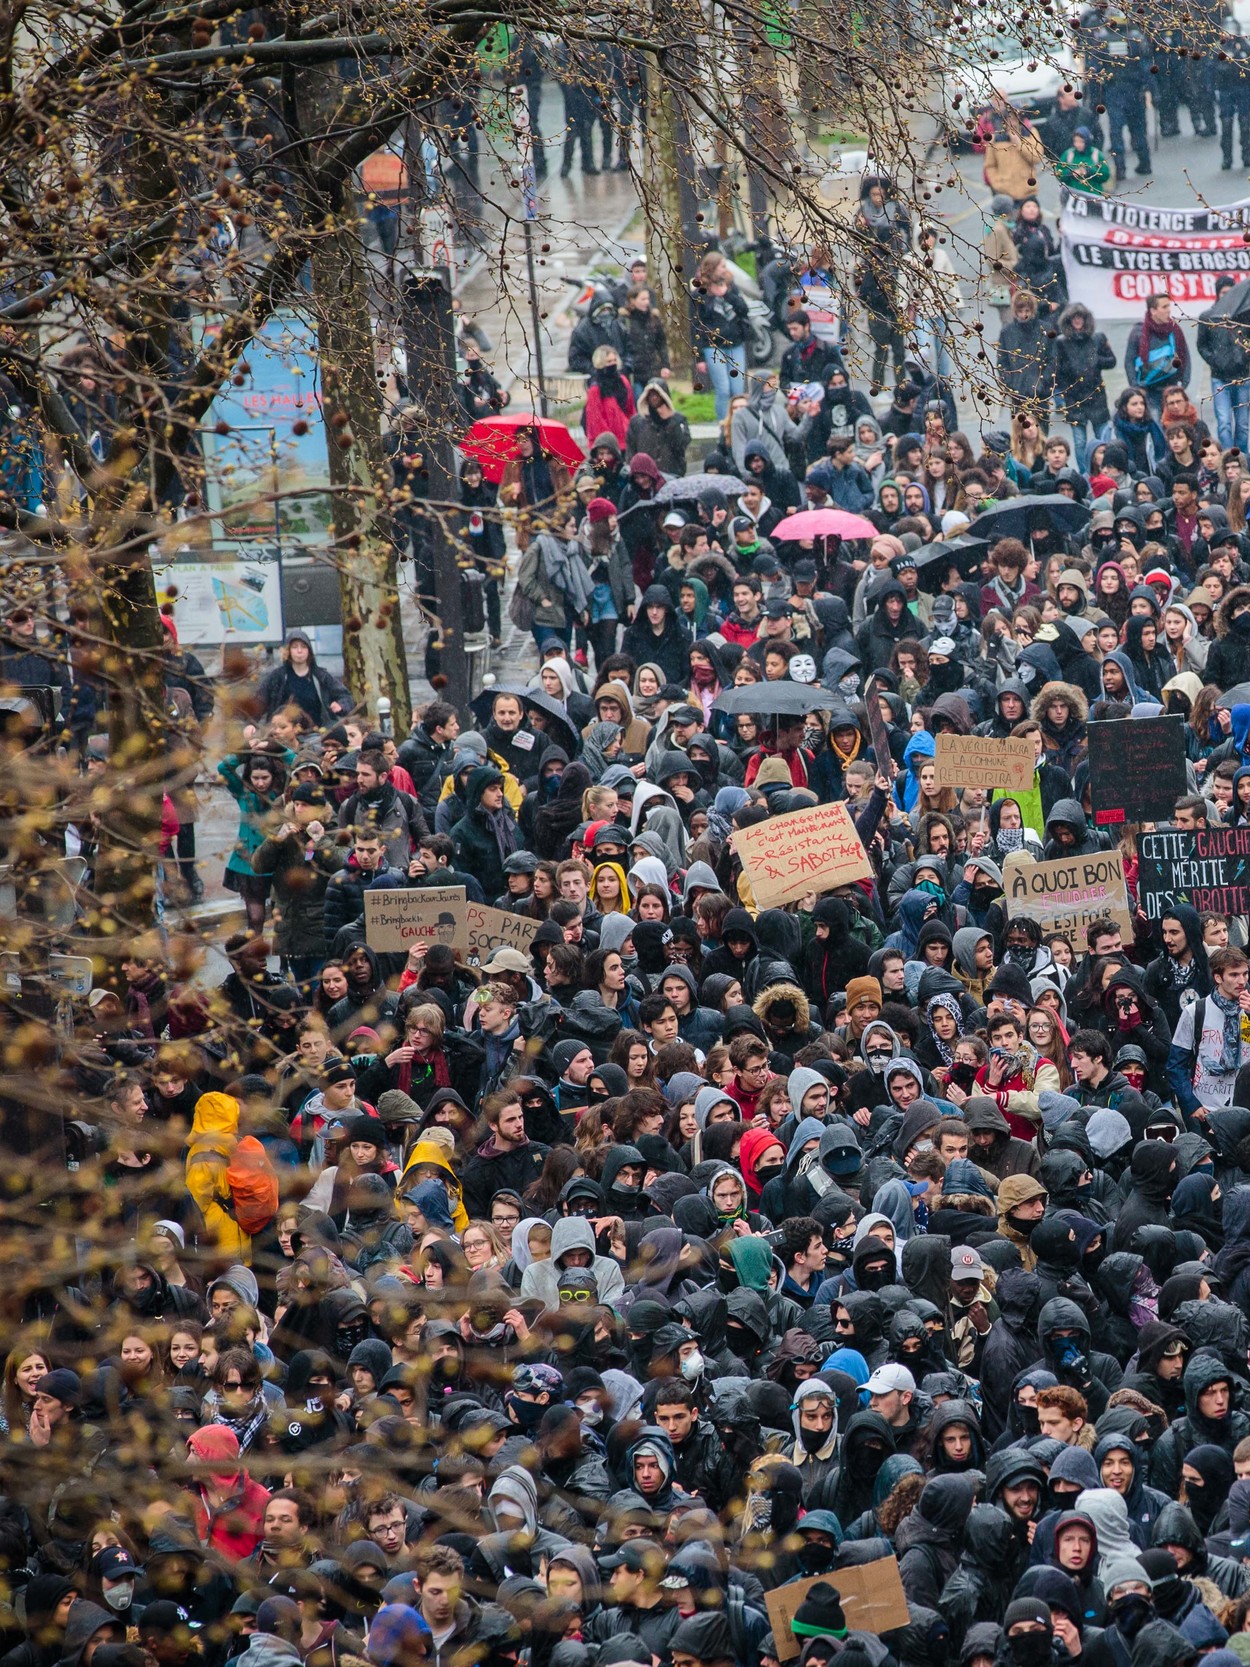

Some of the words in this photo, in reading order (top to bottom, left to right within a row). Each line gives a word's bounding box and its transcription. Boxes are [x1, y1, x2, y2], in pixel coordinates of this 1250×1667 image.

[1066, 196, 1088, 217] LA
[1102, 202, 1195, 231] VIOLENCE
[1079, 244, 1103, 265] LE
[244, 395, 267, 407] LES
[941, 738, 957, 752] LA
[952, 755, 966, 766] LA
[940, 766, 1013, 785] REFLEURIRA
[1142, 833, 1189, 860] CETTE
[765, 865, 785, 879] &
[1013, 867, 1028, 898] À
[1031, 867, 1079, 893] QUOI
[1083, 859, 1122, 886] BON
[1171, 857, 1229, 888] MÉRITE
[401, 926, 437, 938] GAUCHE
